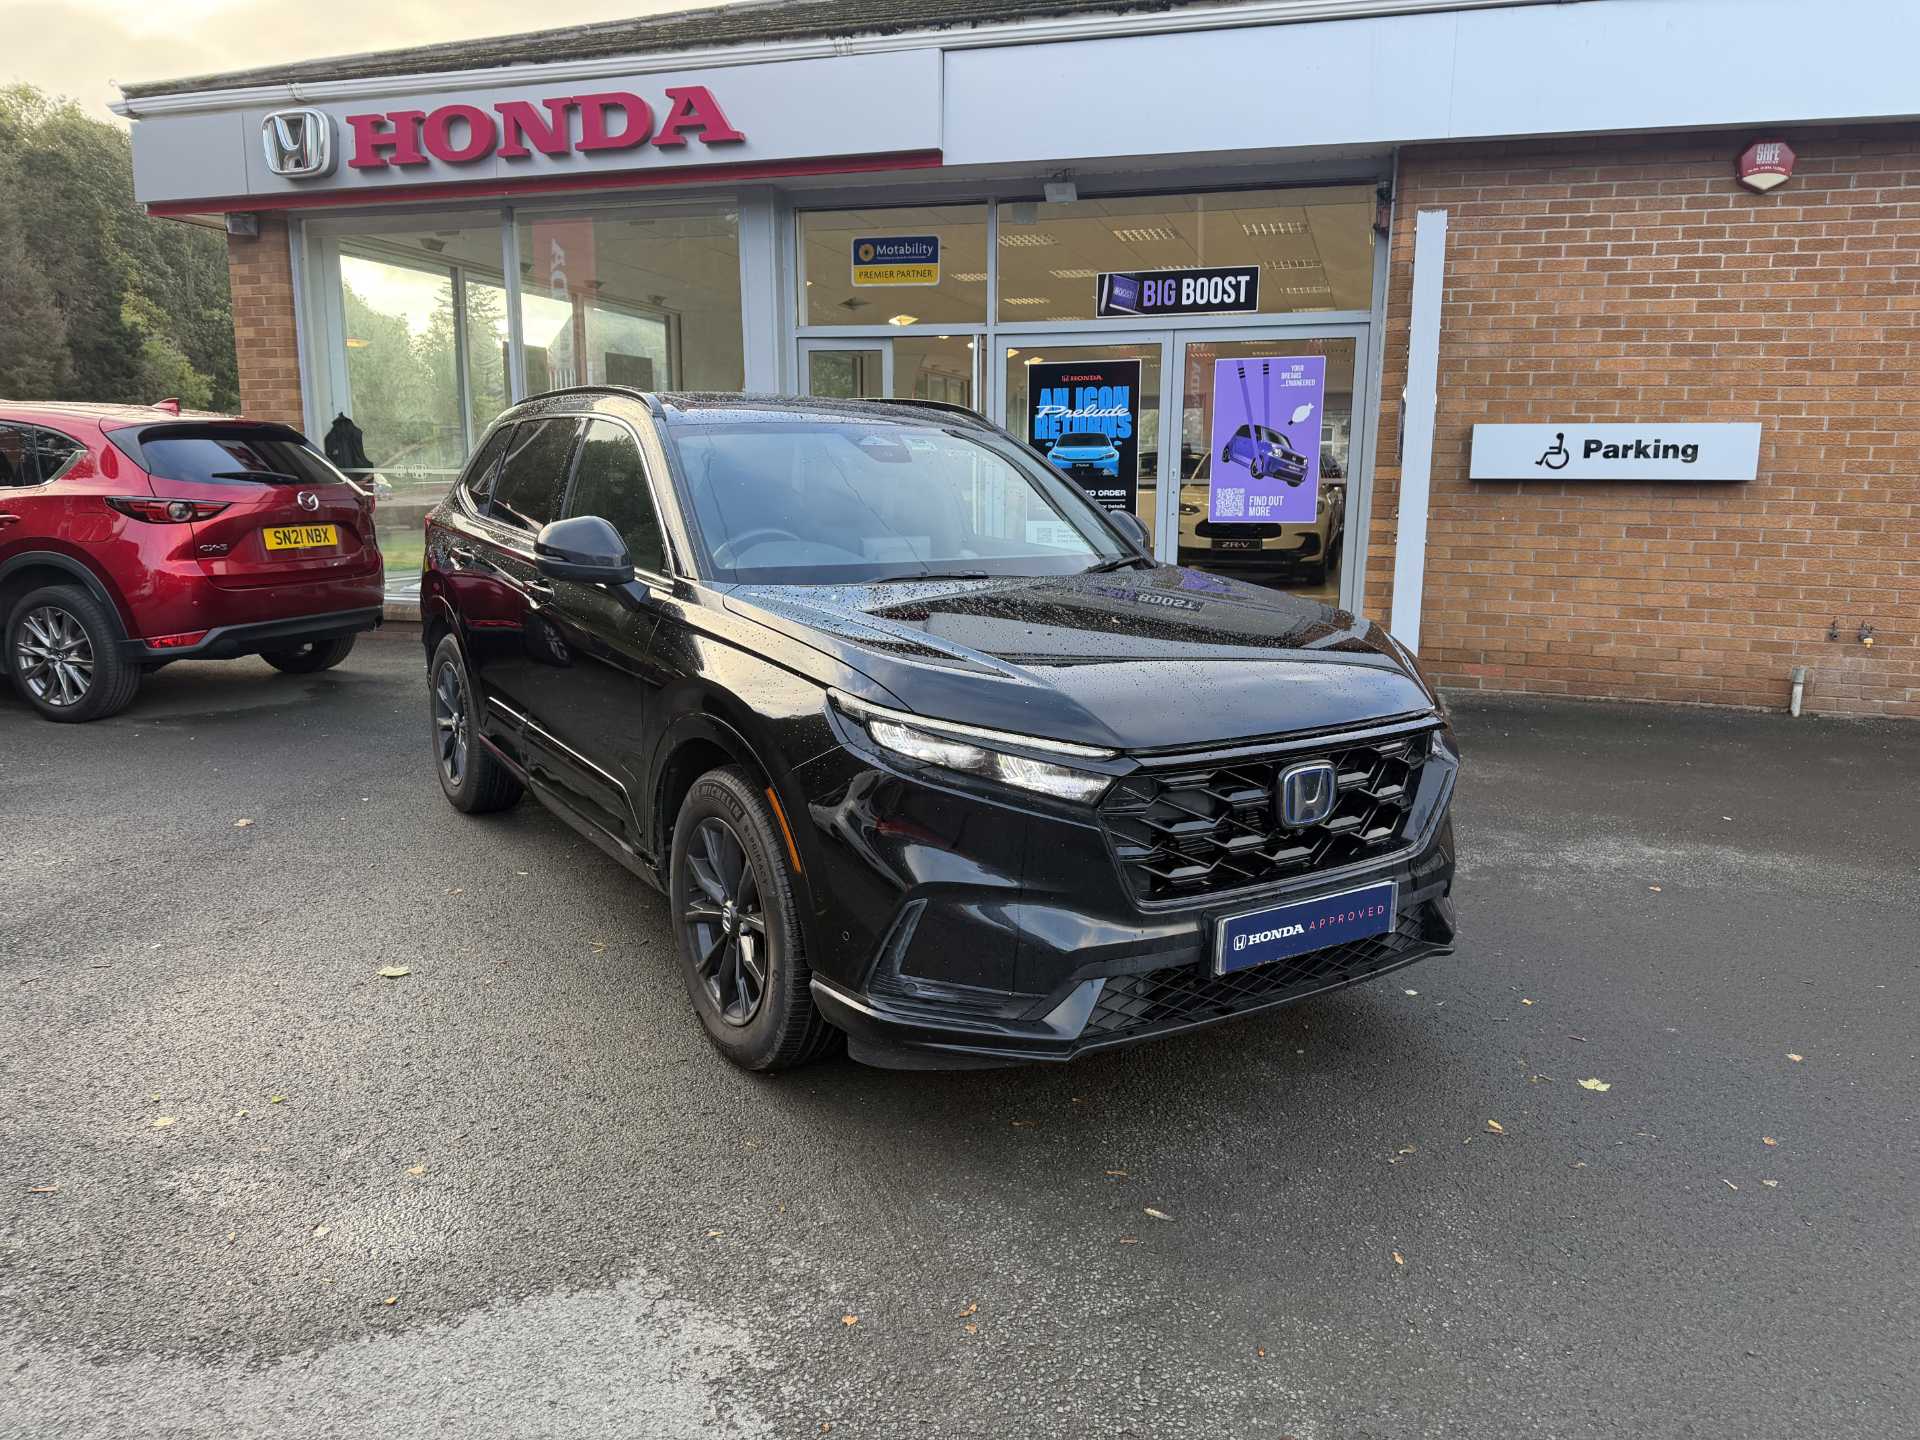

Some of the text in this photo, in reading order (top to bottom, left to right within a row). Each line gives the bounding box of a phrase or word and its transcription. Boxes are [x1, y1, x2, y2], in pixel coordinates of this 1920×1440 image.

[347, 86, 745, 168] HONDA
[876, 242, 934, 257] Motability
[859, 269, 933, 279] PREMIER PARTNER
[1143, 275, 1250, 307] BIG BOOST
[1039, 386, 1130, 412] AN ICON
[1036, 404, 1130, 418] Prelude
[1035, 414, 1132, 440] RETURNS
[1583, 439, 1699, 463] Parking
[1098, 489, 1126, 497] ORDER
[1249, 495, 1284, 506] FIND OUT
[1249, 506, 1271, 516] MORE
[273, 528, 330, 545] SN21 NBX
[1248, 905, 1385, 945] HONDA APPROVED
